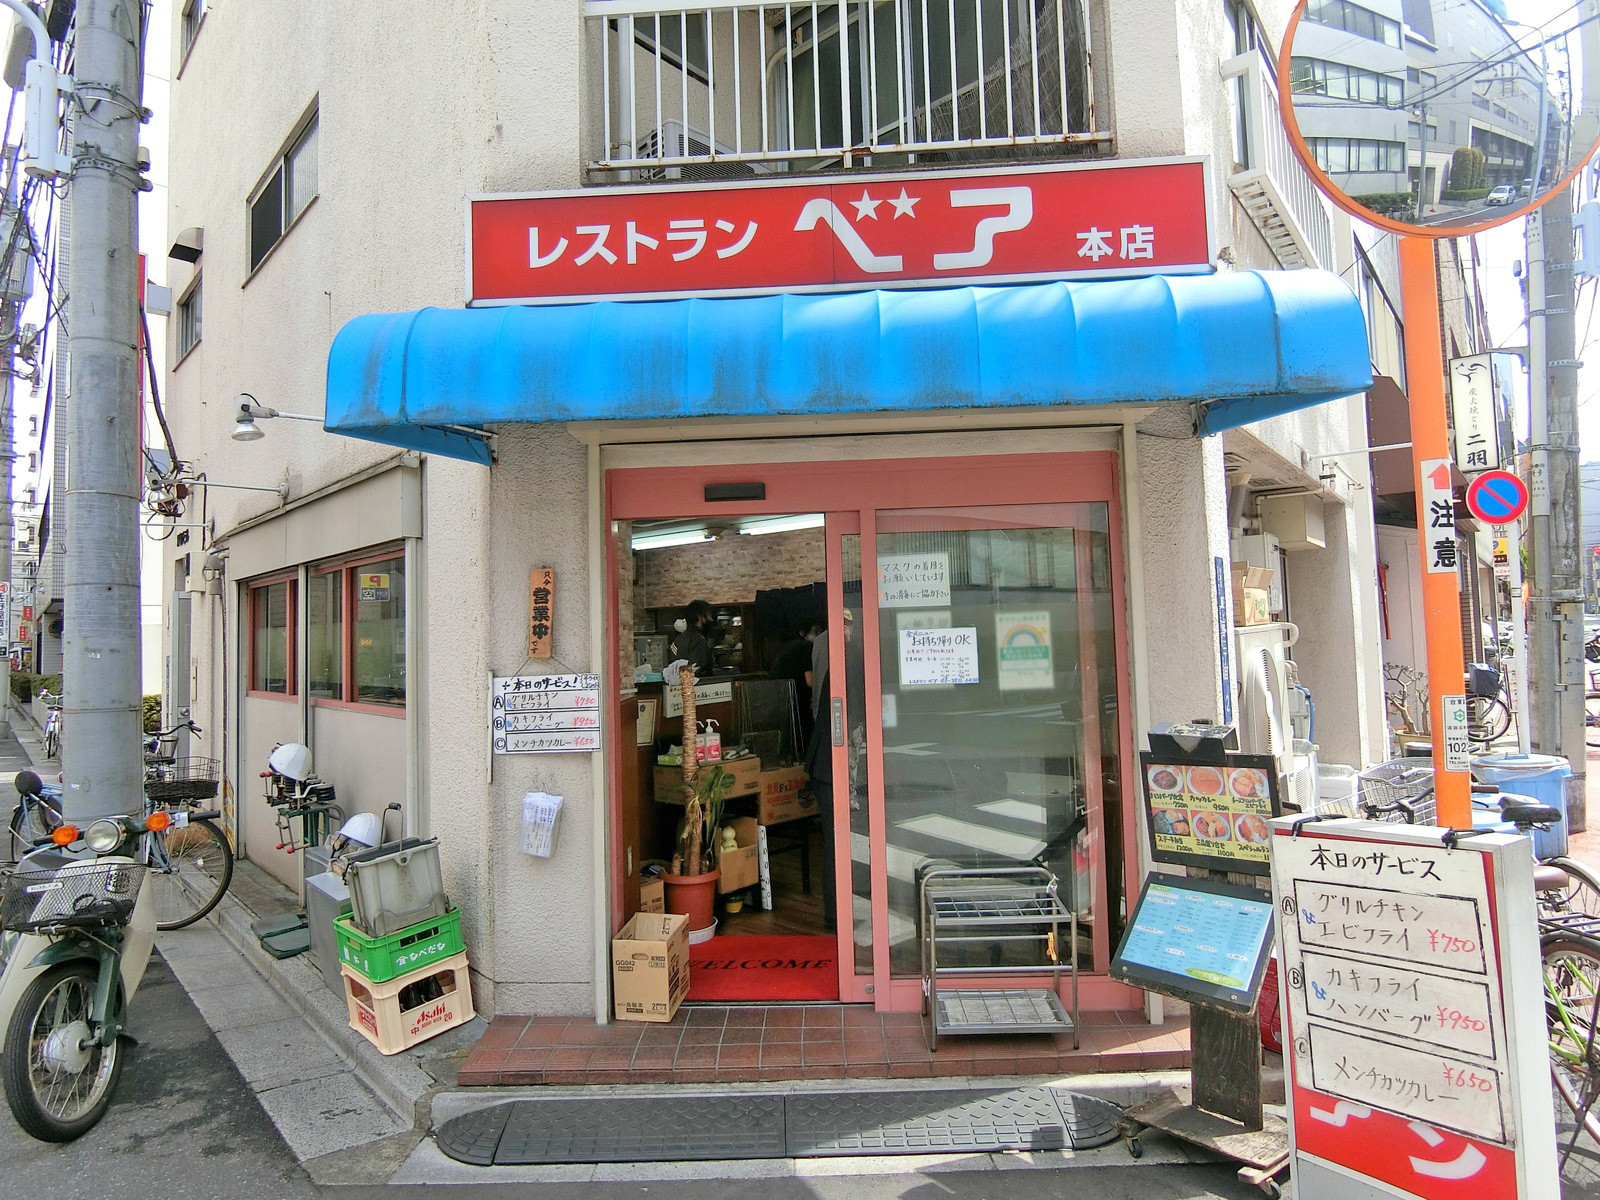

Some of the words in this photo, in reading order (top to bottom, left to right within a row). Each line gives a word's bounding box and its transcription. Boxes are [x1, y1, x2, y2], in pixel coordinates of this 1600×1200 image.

[528, 219, 759, 269] レストラン
[793, 185, 1034, 273] ベア
[1076, 224, 1155, 261] 本店
[1466, 434, 1487, 466] 二羽
[1430, 498, 1457, 568] 注意
[883, 572, 944, 584] お願いしています
[532, 587, 551, 640] 営業中
[954, 634, 971, 645] OK
[511, 692, 559, 702] グリルチキン
[512, 700, 550, 709] エビフライ
[512, 713, 553, 724] カキフライ
[513, 738, 572, 749] メンチカツカレー
[1309, 843, 1442, 882] 本日のサービス
[1318, 893, 1425, 922] グリルチキン
[1302, 908, 1317, 925] &
[1317, 921, 1410, 951] エビフライ
[1426, 928, 1476, 953] ¥750
[1326, 968, 1420, 1002] カキフライ
[416, 1002, 446, 1024] Asahi
[444, 1011, 453, 1022] 20
[1311, 981, 1327, 1000] &
[1326, 999, 1432, 1034] ハンバーグ
[1437, 1005, 1486, 1032] ¥950
[1333, 1056, 1460, 1102] メンチカツカレー
[1442, 1062, 1492, 1092] ¥650
